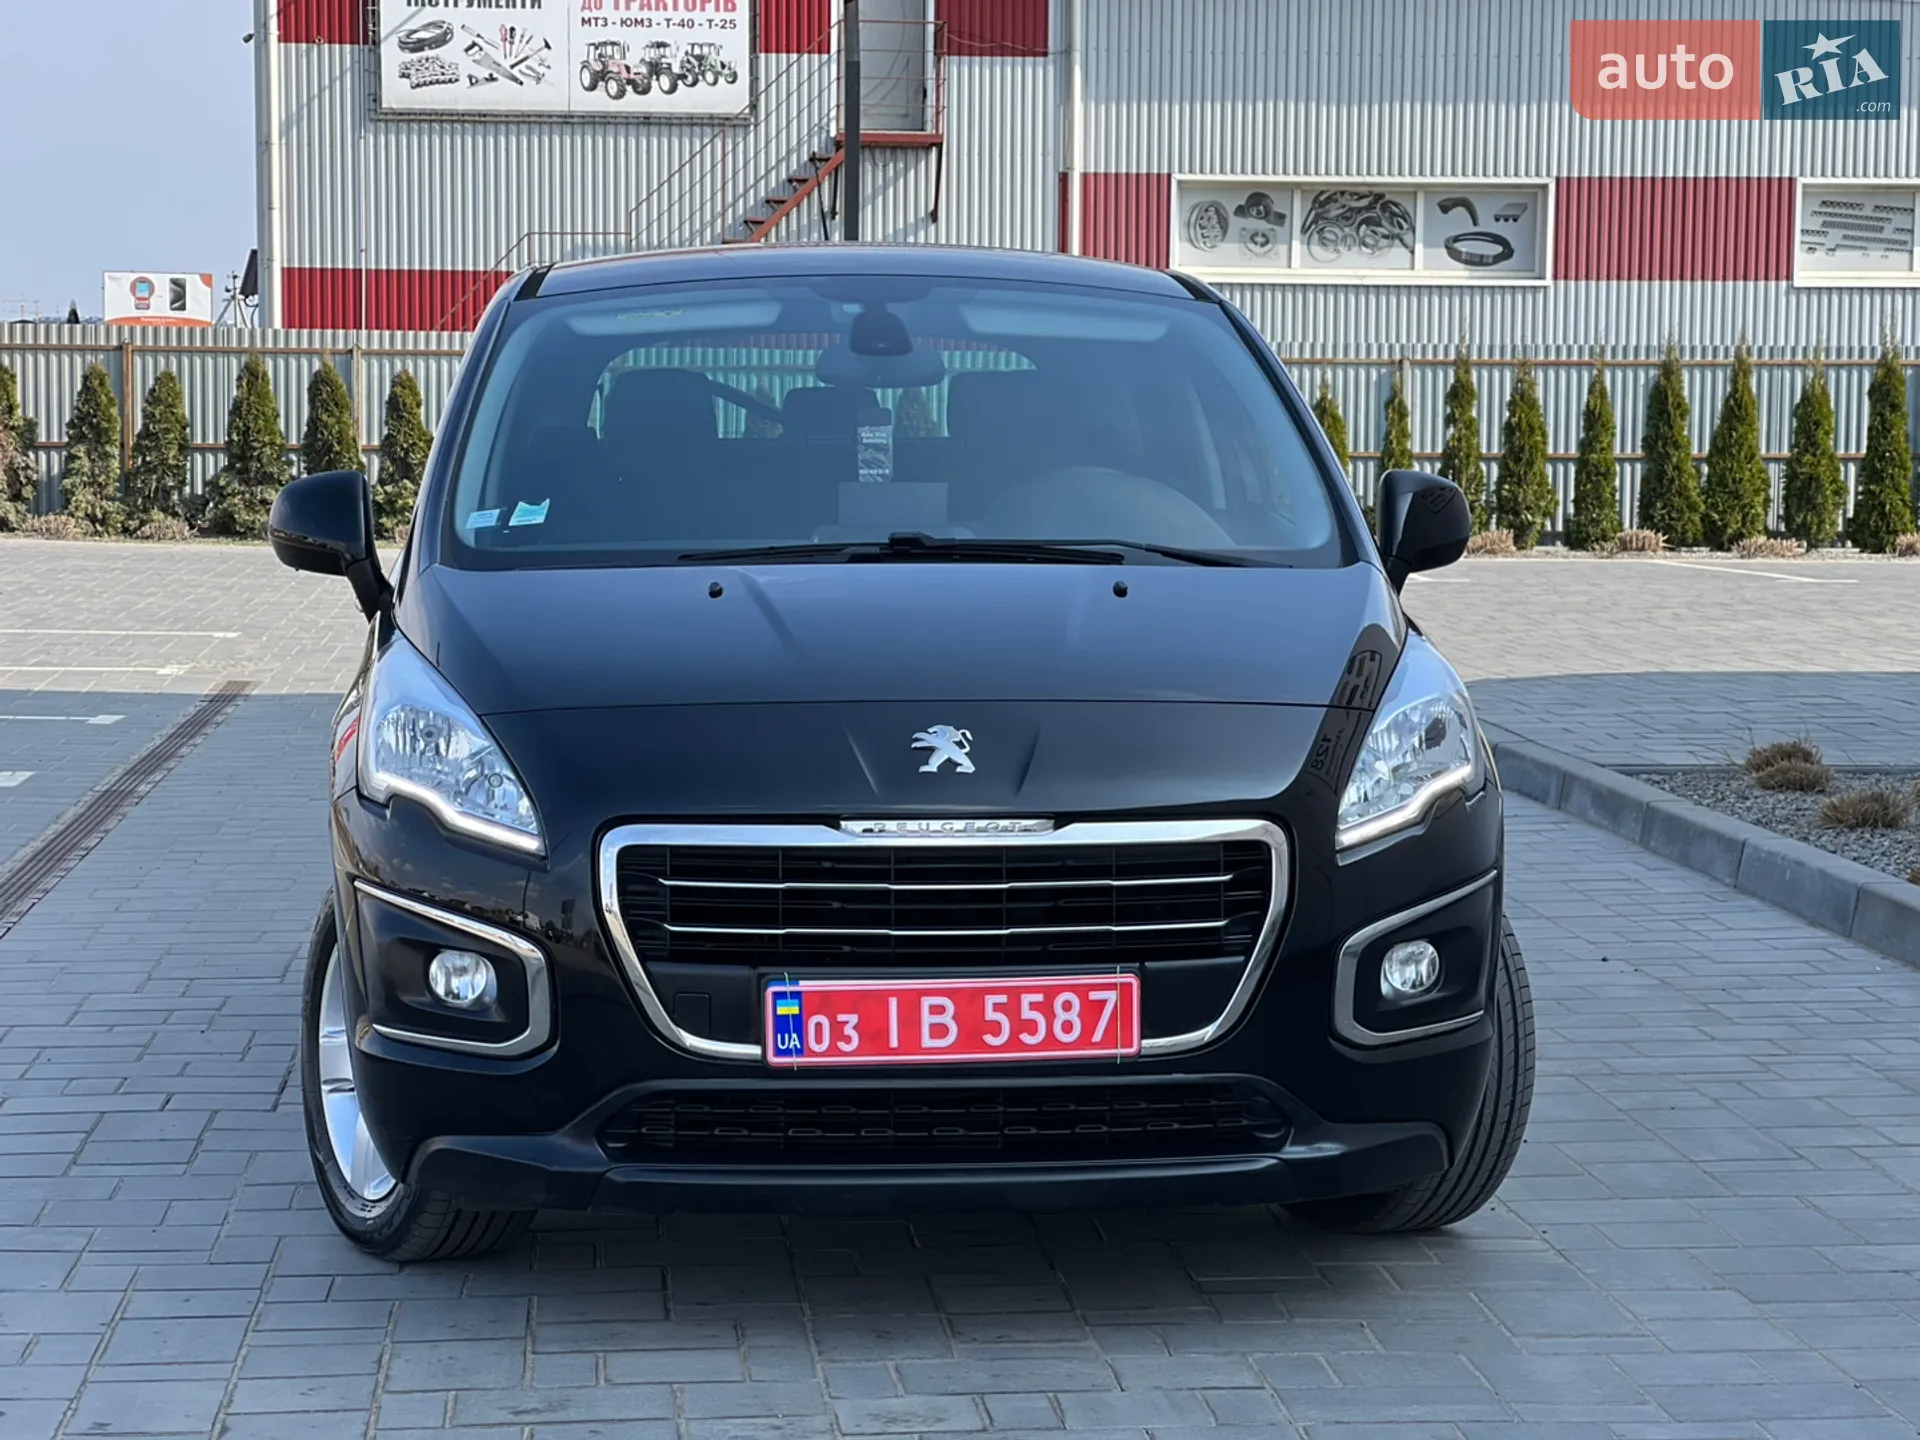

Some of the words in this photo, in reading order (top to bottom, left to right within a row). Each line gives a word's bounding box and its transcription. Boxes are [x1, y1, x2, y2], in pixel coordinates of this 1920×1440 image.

[581, 17, 608, 28] МТЗ
[620, 17, 653, 28] ЮМЗ
[664, 18, 695, 29] Т-40
[706, 18, 737, 30] Т-25
[873, 821, 1023, 833] PEUGEOT
[777, 1033, 801, 1049] UA
[807, 1014, 859, 1053] 03
[982, 991, 1118, 1047] 5587
